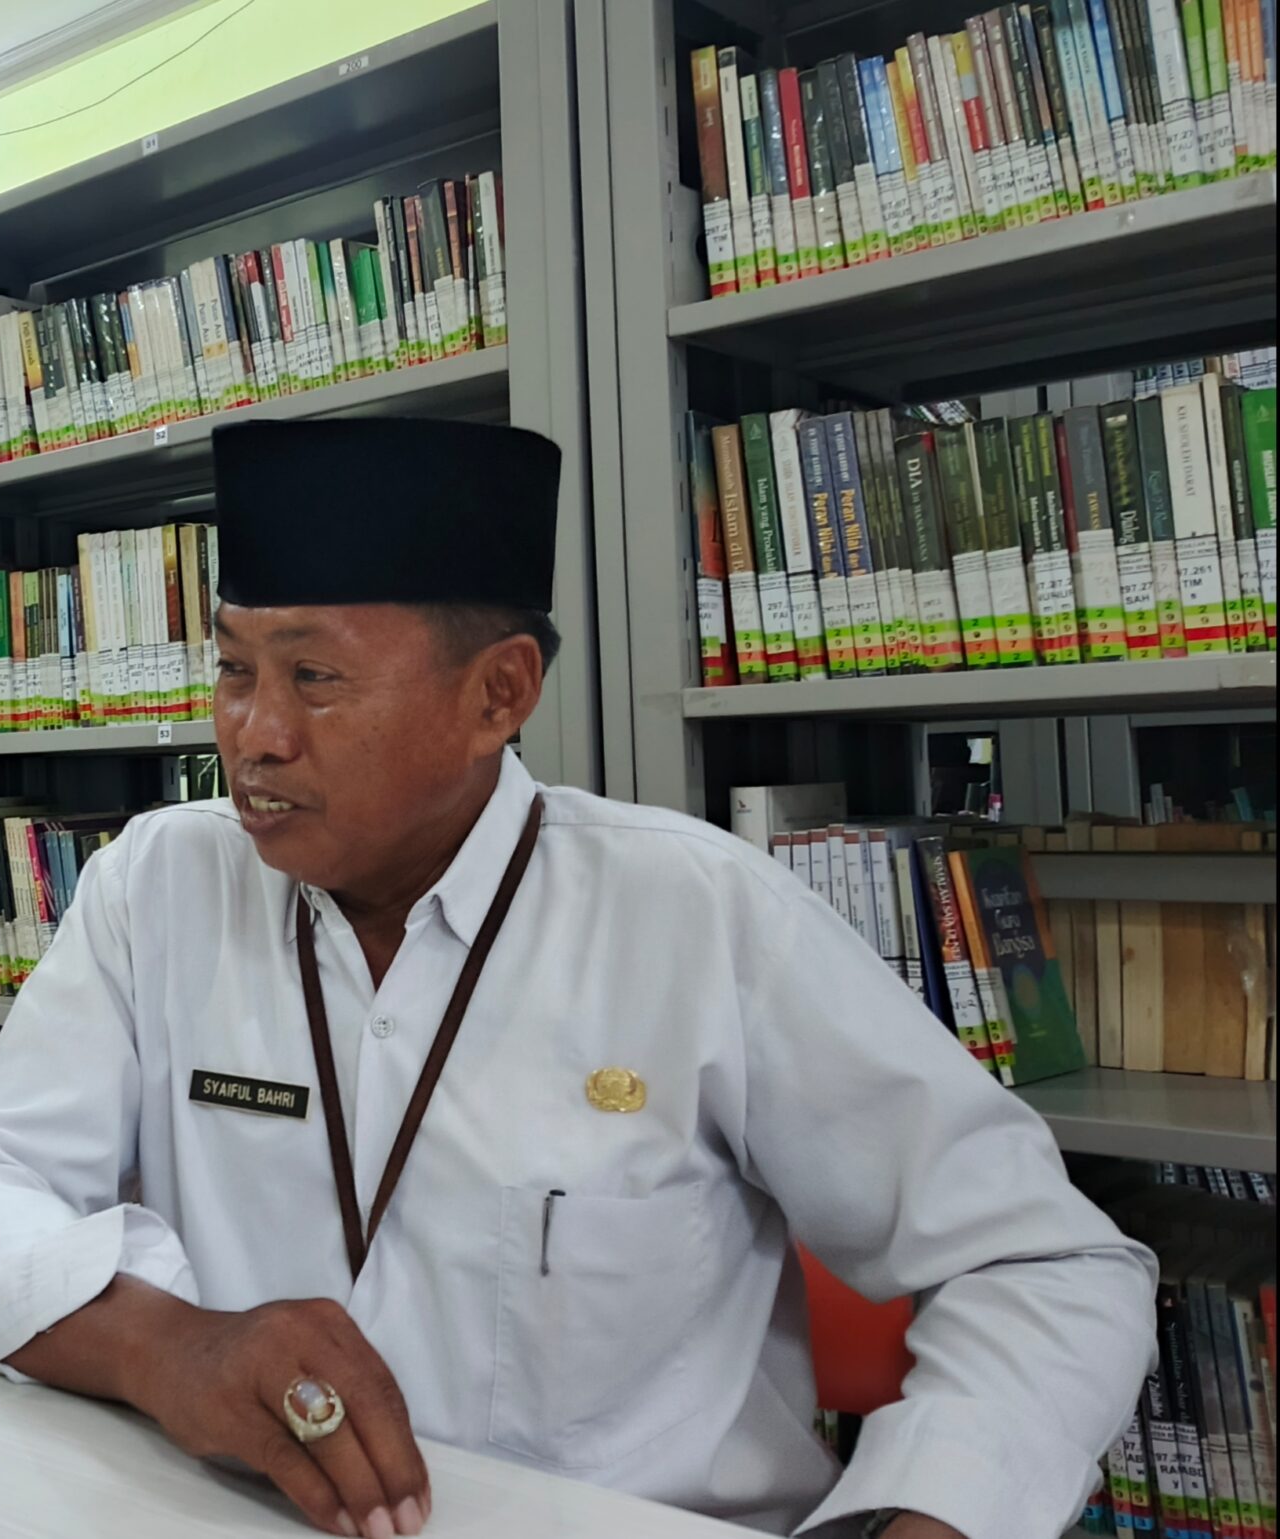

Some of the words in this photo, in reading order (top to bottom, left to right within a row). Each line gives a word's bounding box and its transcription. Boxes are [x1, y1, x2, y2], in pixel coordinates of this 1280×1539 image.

[156, 432, 167, 442] 52
[907, 457, 923, 489] DIA
[1184, 466, 1197, 497] DARAT
[757, 478, 769, 507] Islam
[840, 488, 855, 522] Peran
[724, 493, 740, 538] Islam
[759, 509, 770, 528] yang
[814, 492, 829, 526] Peran
[844, 523, 864, 551] Nilai
[1120, 510, 1141, 545] Dialog
[731, 543, 743, 557] di
[1183, 578, 1204, 588] TIM
[1125, 594, 1151, 606] SAH
[159, 728, 170, 739] 53
[934, 855, 951, 904] SEMALAM
[943, 905, 956, 928] SAJA
[203, 1079, 252, 1101] SYAIFUL
[257, 1088, 295, 1109] BAHRI
